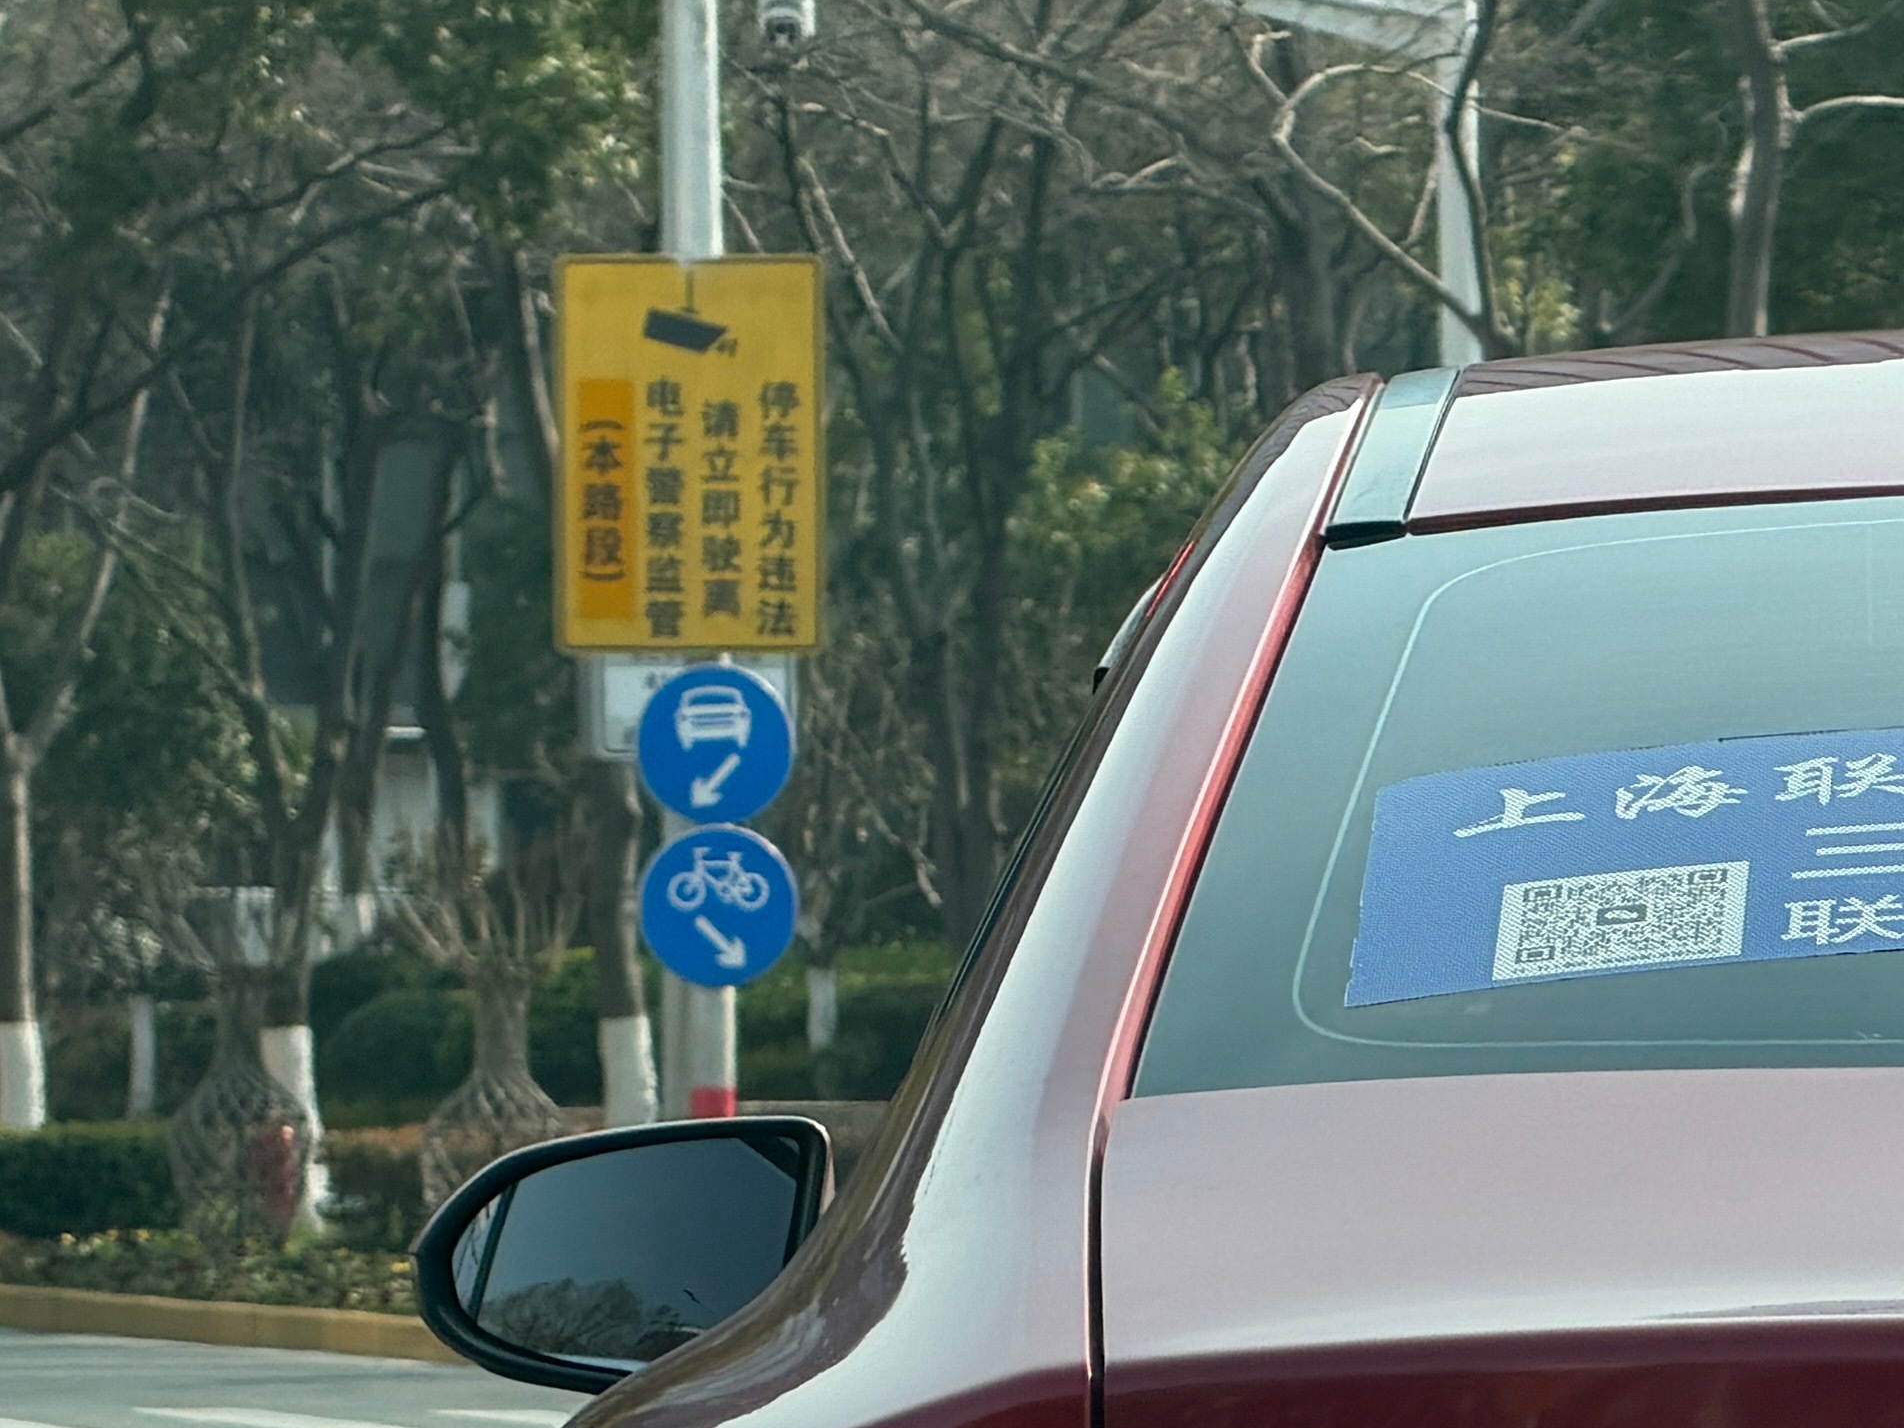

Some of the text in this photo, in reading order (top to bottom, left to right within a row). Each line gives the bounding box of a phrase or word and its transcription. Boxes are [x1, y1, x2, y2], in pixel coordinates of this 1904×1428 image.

[758, 381, 800, 638] 停车行为违法
